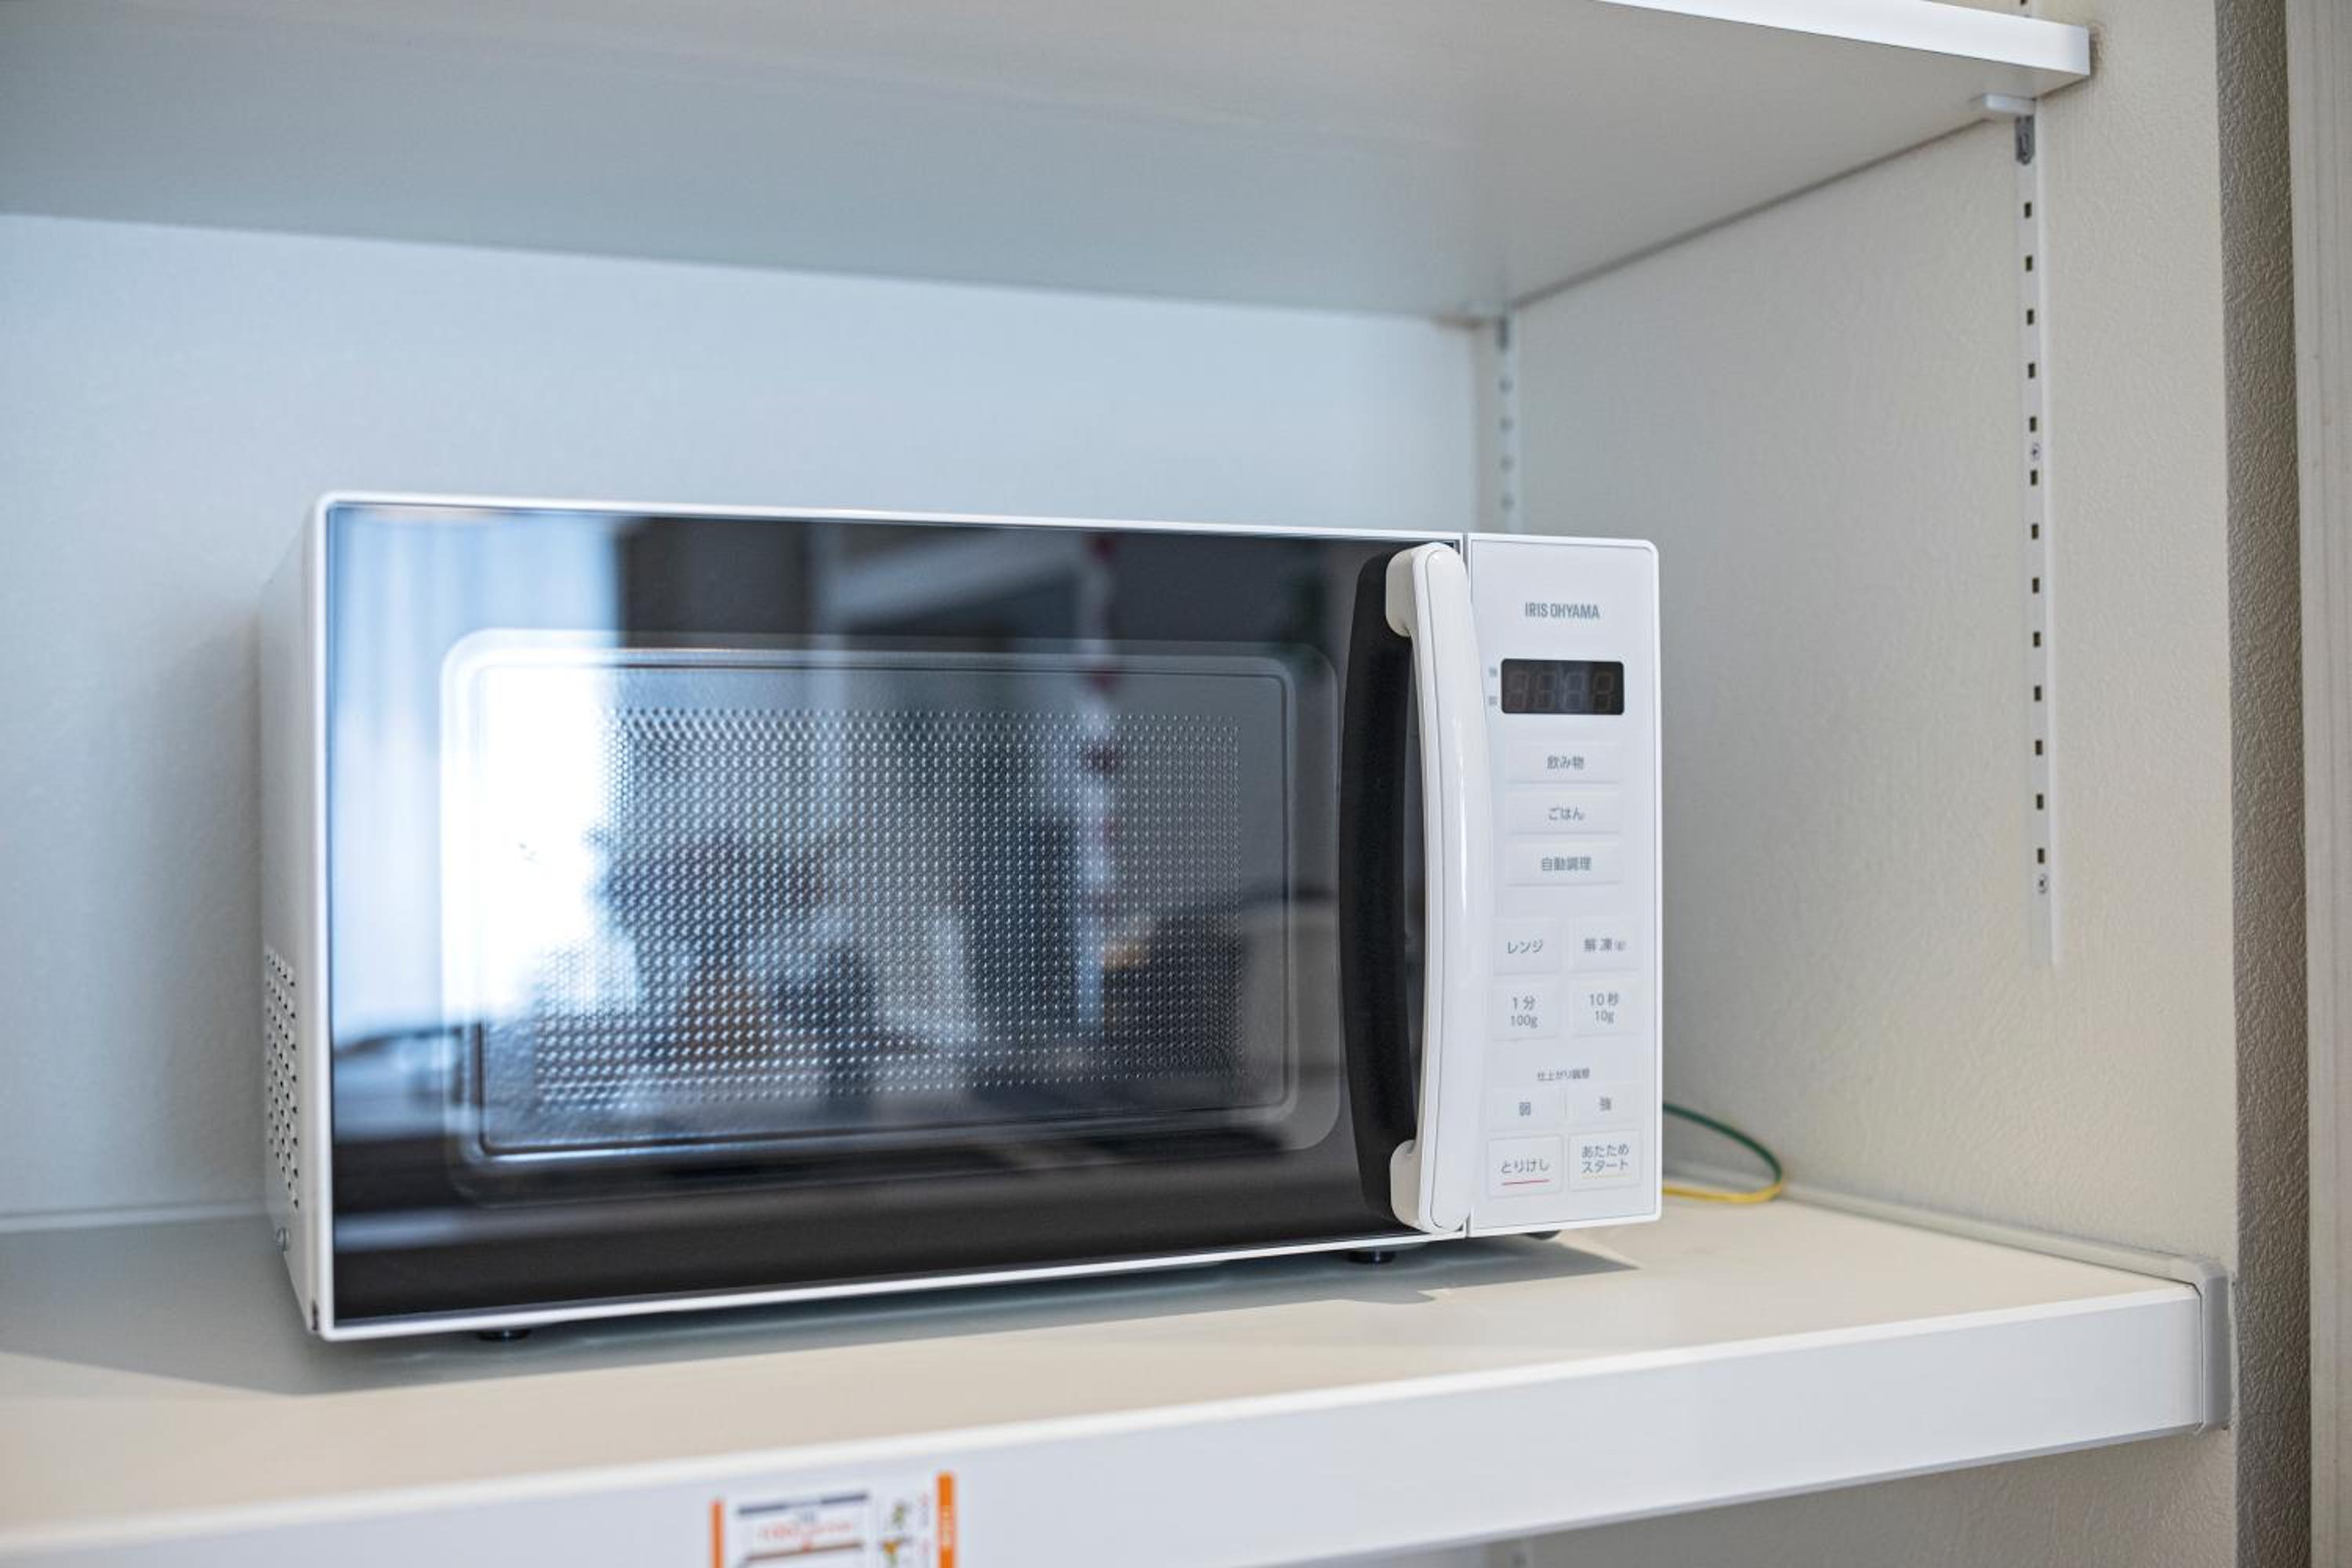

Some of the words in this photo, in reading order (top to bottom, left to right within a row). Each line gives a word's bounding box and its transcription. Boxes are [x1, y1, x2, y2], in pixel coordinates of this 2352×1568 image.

[1525, 602, 1548, 617] IRIS
[1550, 603, 1600, 619] OHYAMA
[1547, 755, 1584, 770] 飲み物
[1548, 807, 1585, 821] ごはん
[1507, 940, 1544, 954] レンジ
[1511, 1014, 1537, 1029] 100g
[1595, 1010, 1614, 1024] 10g
[1581, 1144, 1630, 1159] あたため
[1501, 1159, 1550, 1174] とりけし
[1582, 1159, 1629, 1174] スタート
